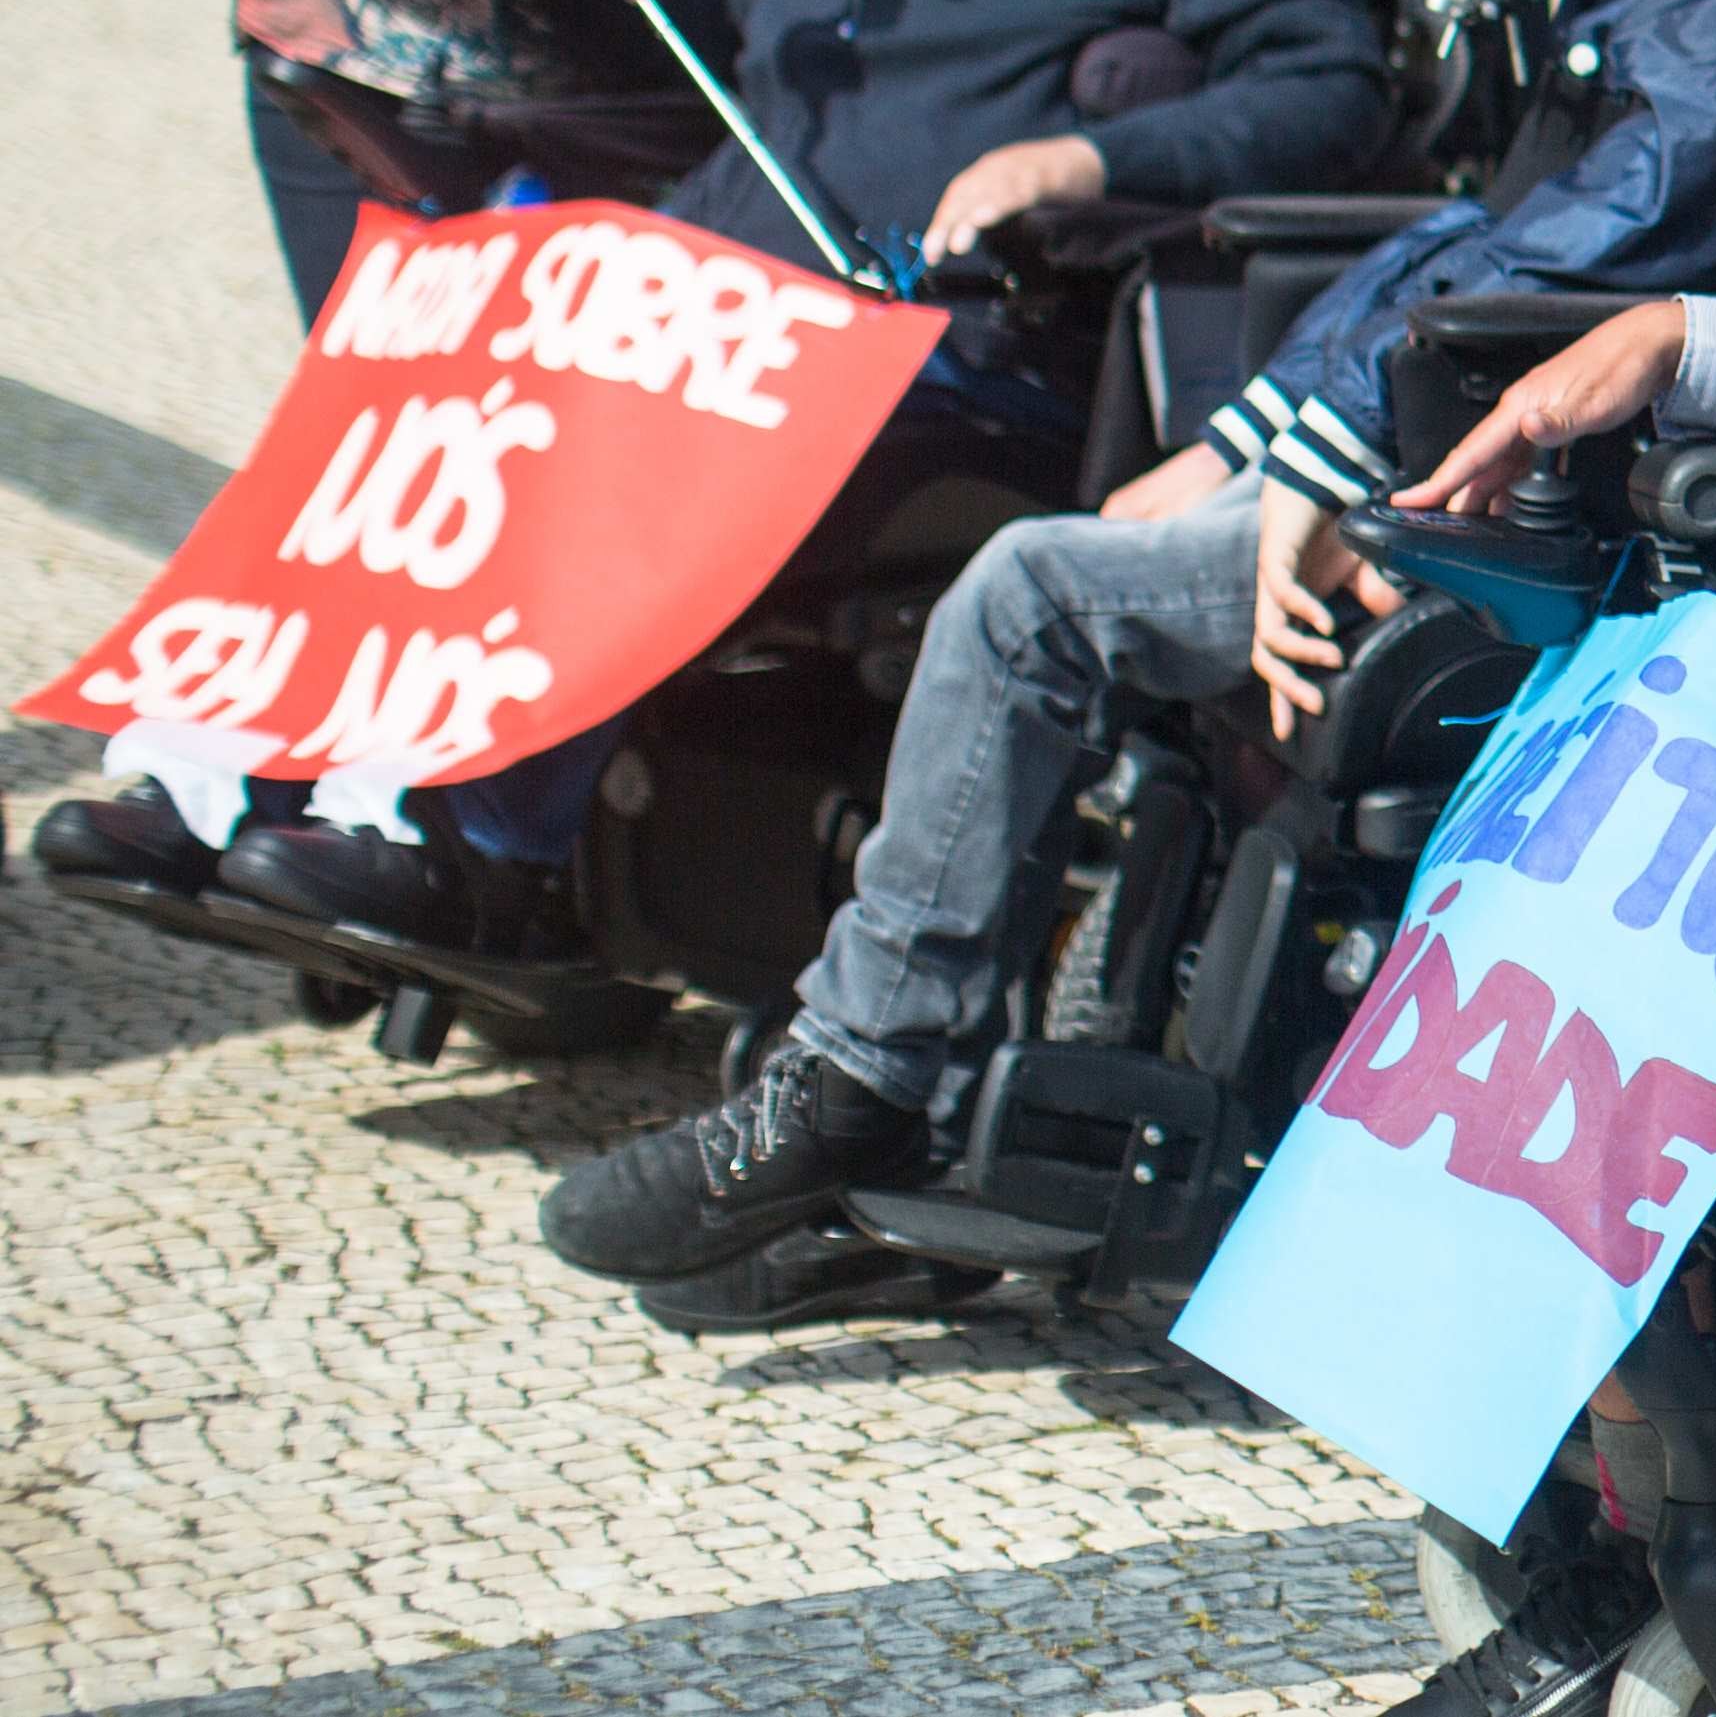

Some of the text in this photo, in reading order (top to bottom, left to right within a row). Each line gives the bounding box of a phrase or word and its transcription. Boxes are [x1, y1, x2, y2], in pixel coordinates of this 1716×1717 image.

[490, 220, 854, 430] SOBRE
[277, 372, 557, 590] NÓS
[78, 597, 554, 772] SEM NÓS
